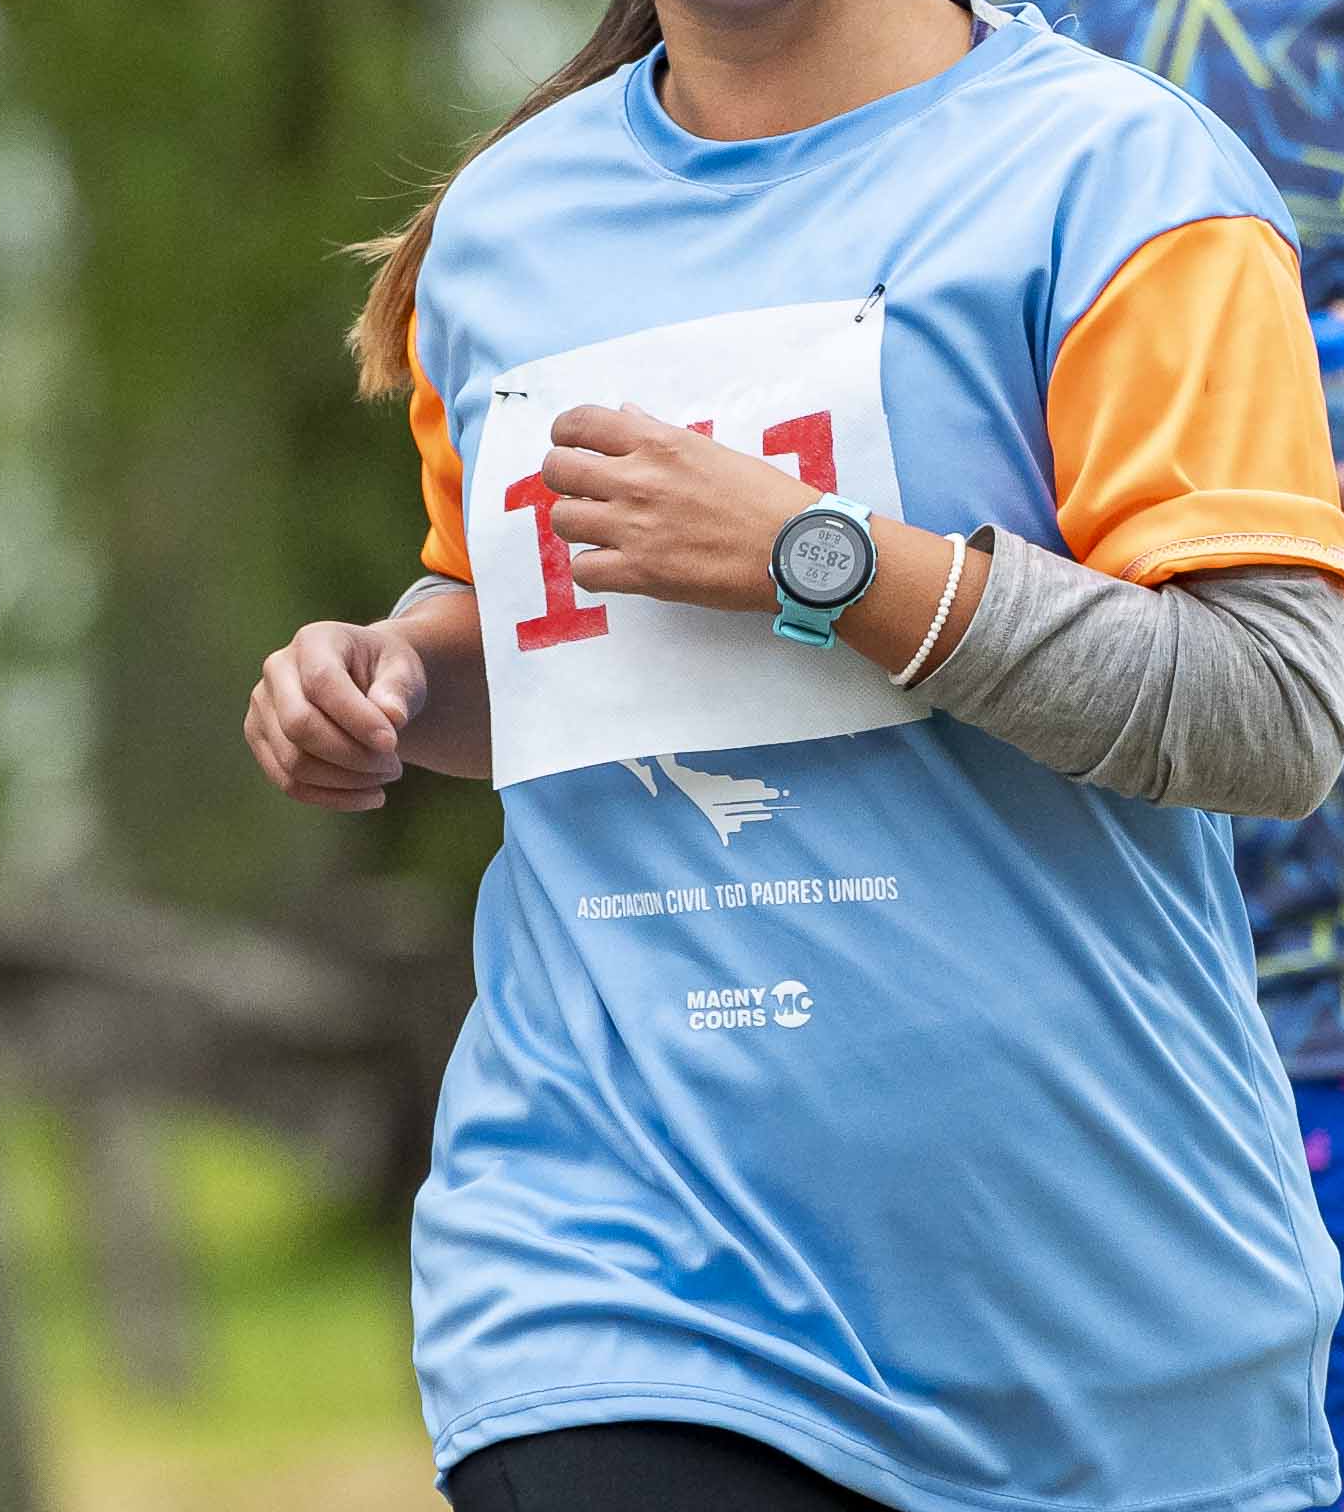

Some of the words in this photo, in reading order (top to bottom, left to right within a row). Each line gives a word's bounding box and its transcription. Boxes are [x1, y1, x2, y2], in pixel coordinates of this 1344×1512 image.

[504, 409, 838, 651] 11
[796, 541, 851, 570] 28:55
[576, 890, 664, 920] ASOCIACION
[666, 888, 711, 915] CIVIL
[715, 883, 747, 909] TGD
[751, 879, 824, 906] PADRES
[829, 876, 898, 903] UNIDOS
[687, 987, 766, 1009] MAGNY
[689, 1009, 767, 1031] COURS
